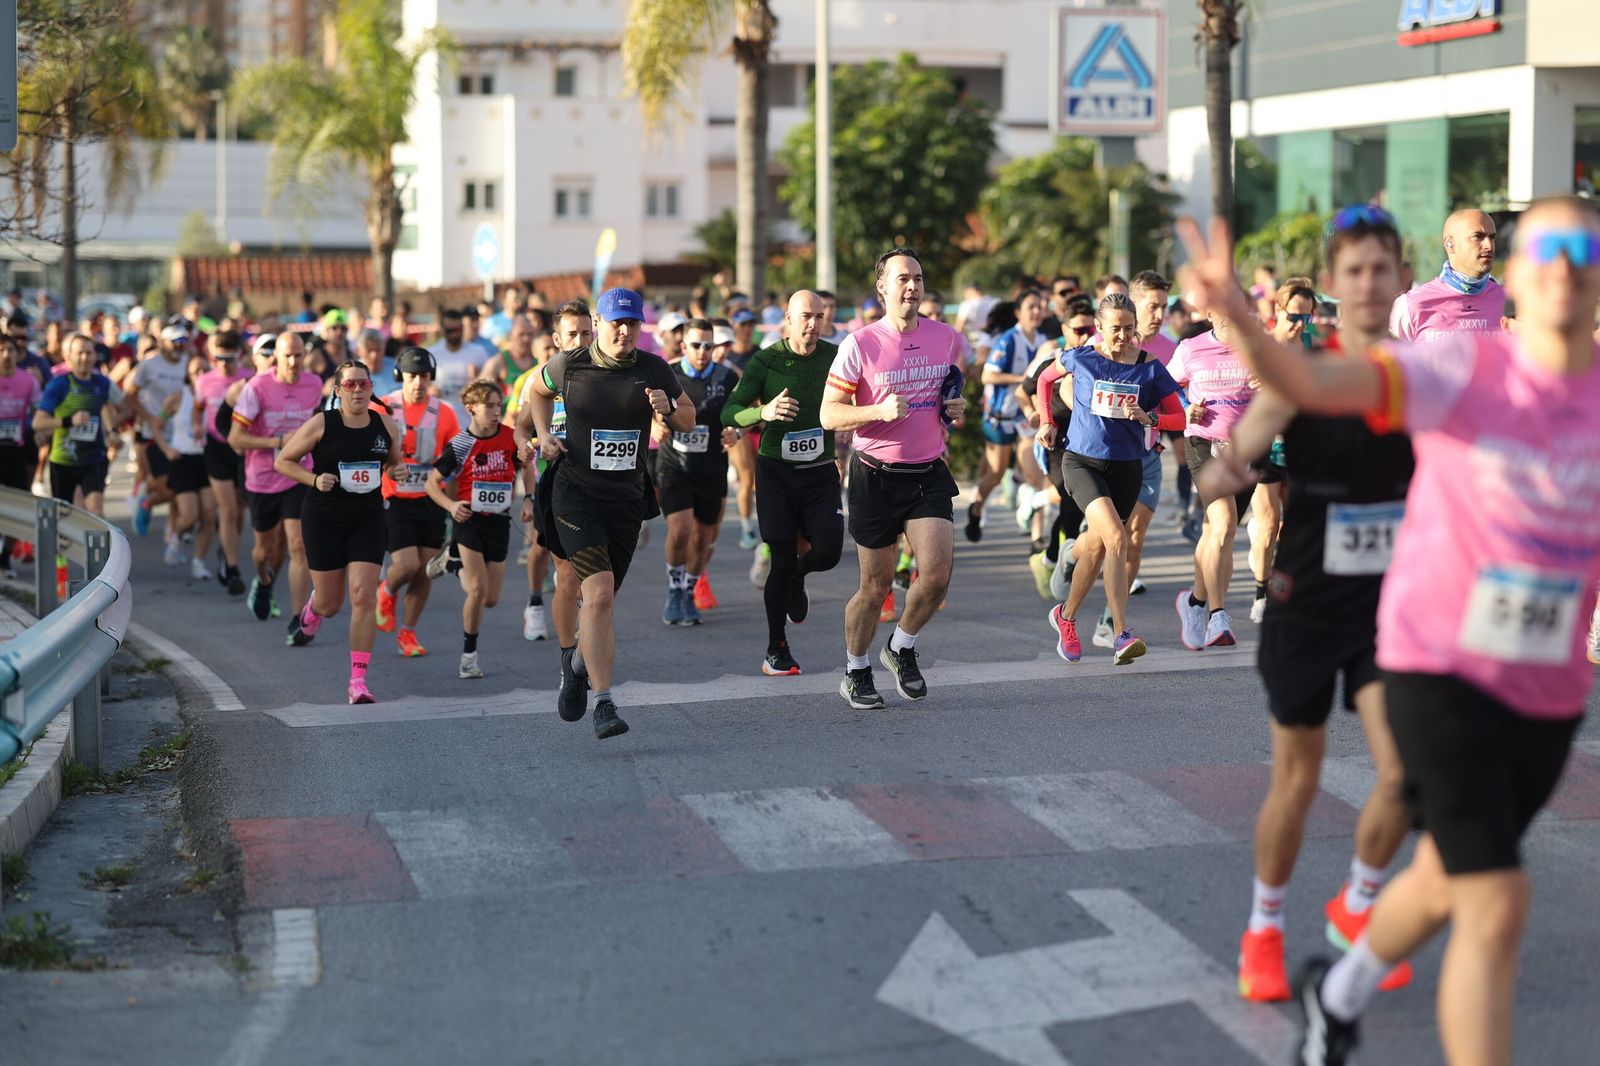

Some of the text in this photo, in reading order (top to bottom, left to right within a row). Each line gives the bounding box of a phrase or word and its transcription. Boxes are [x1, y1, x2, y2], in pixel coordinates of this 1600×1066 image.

[1072, 97, 1147, 119] ALDI
[903, 355, 929, 367] XXXVI
[874, 368, 907, 386] MEDIA
[677, 432, 706, 444] 1557
[594, 441, 636, 457] 2299
[789, 438, 818, 452] 860
[352, 470, 370, 483] 46
[478, 490, 506, 503] 806
